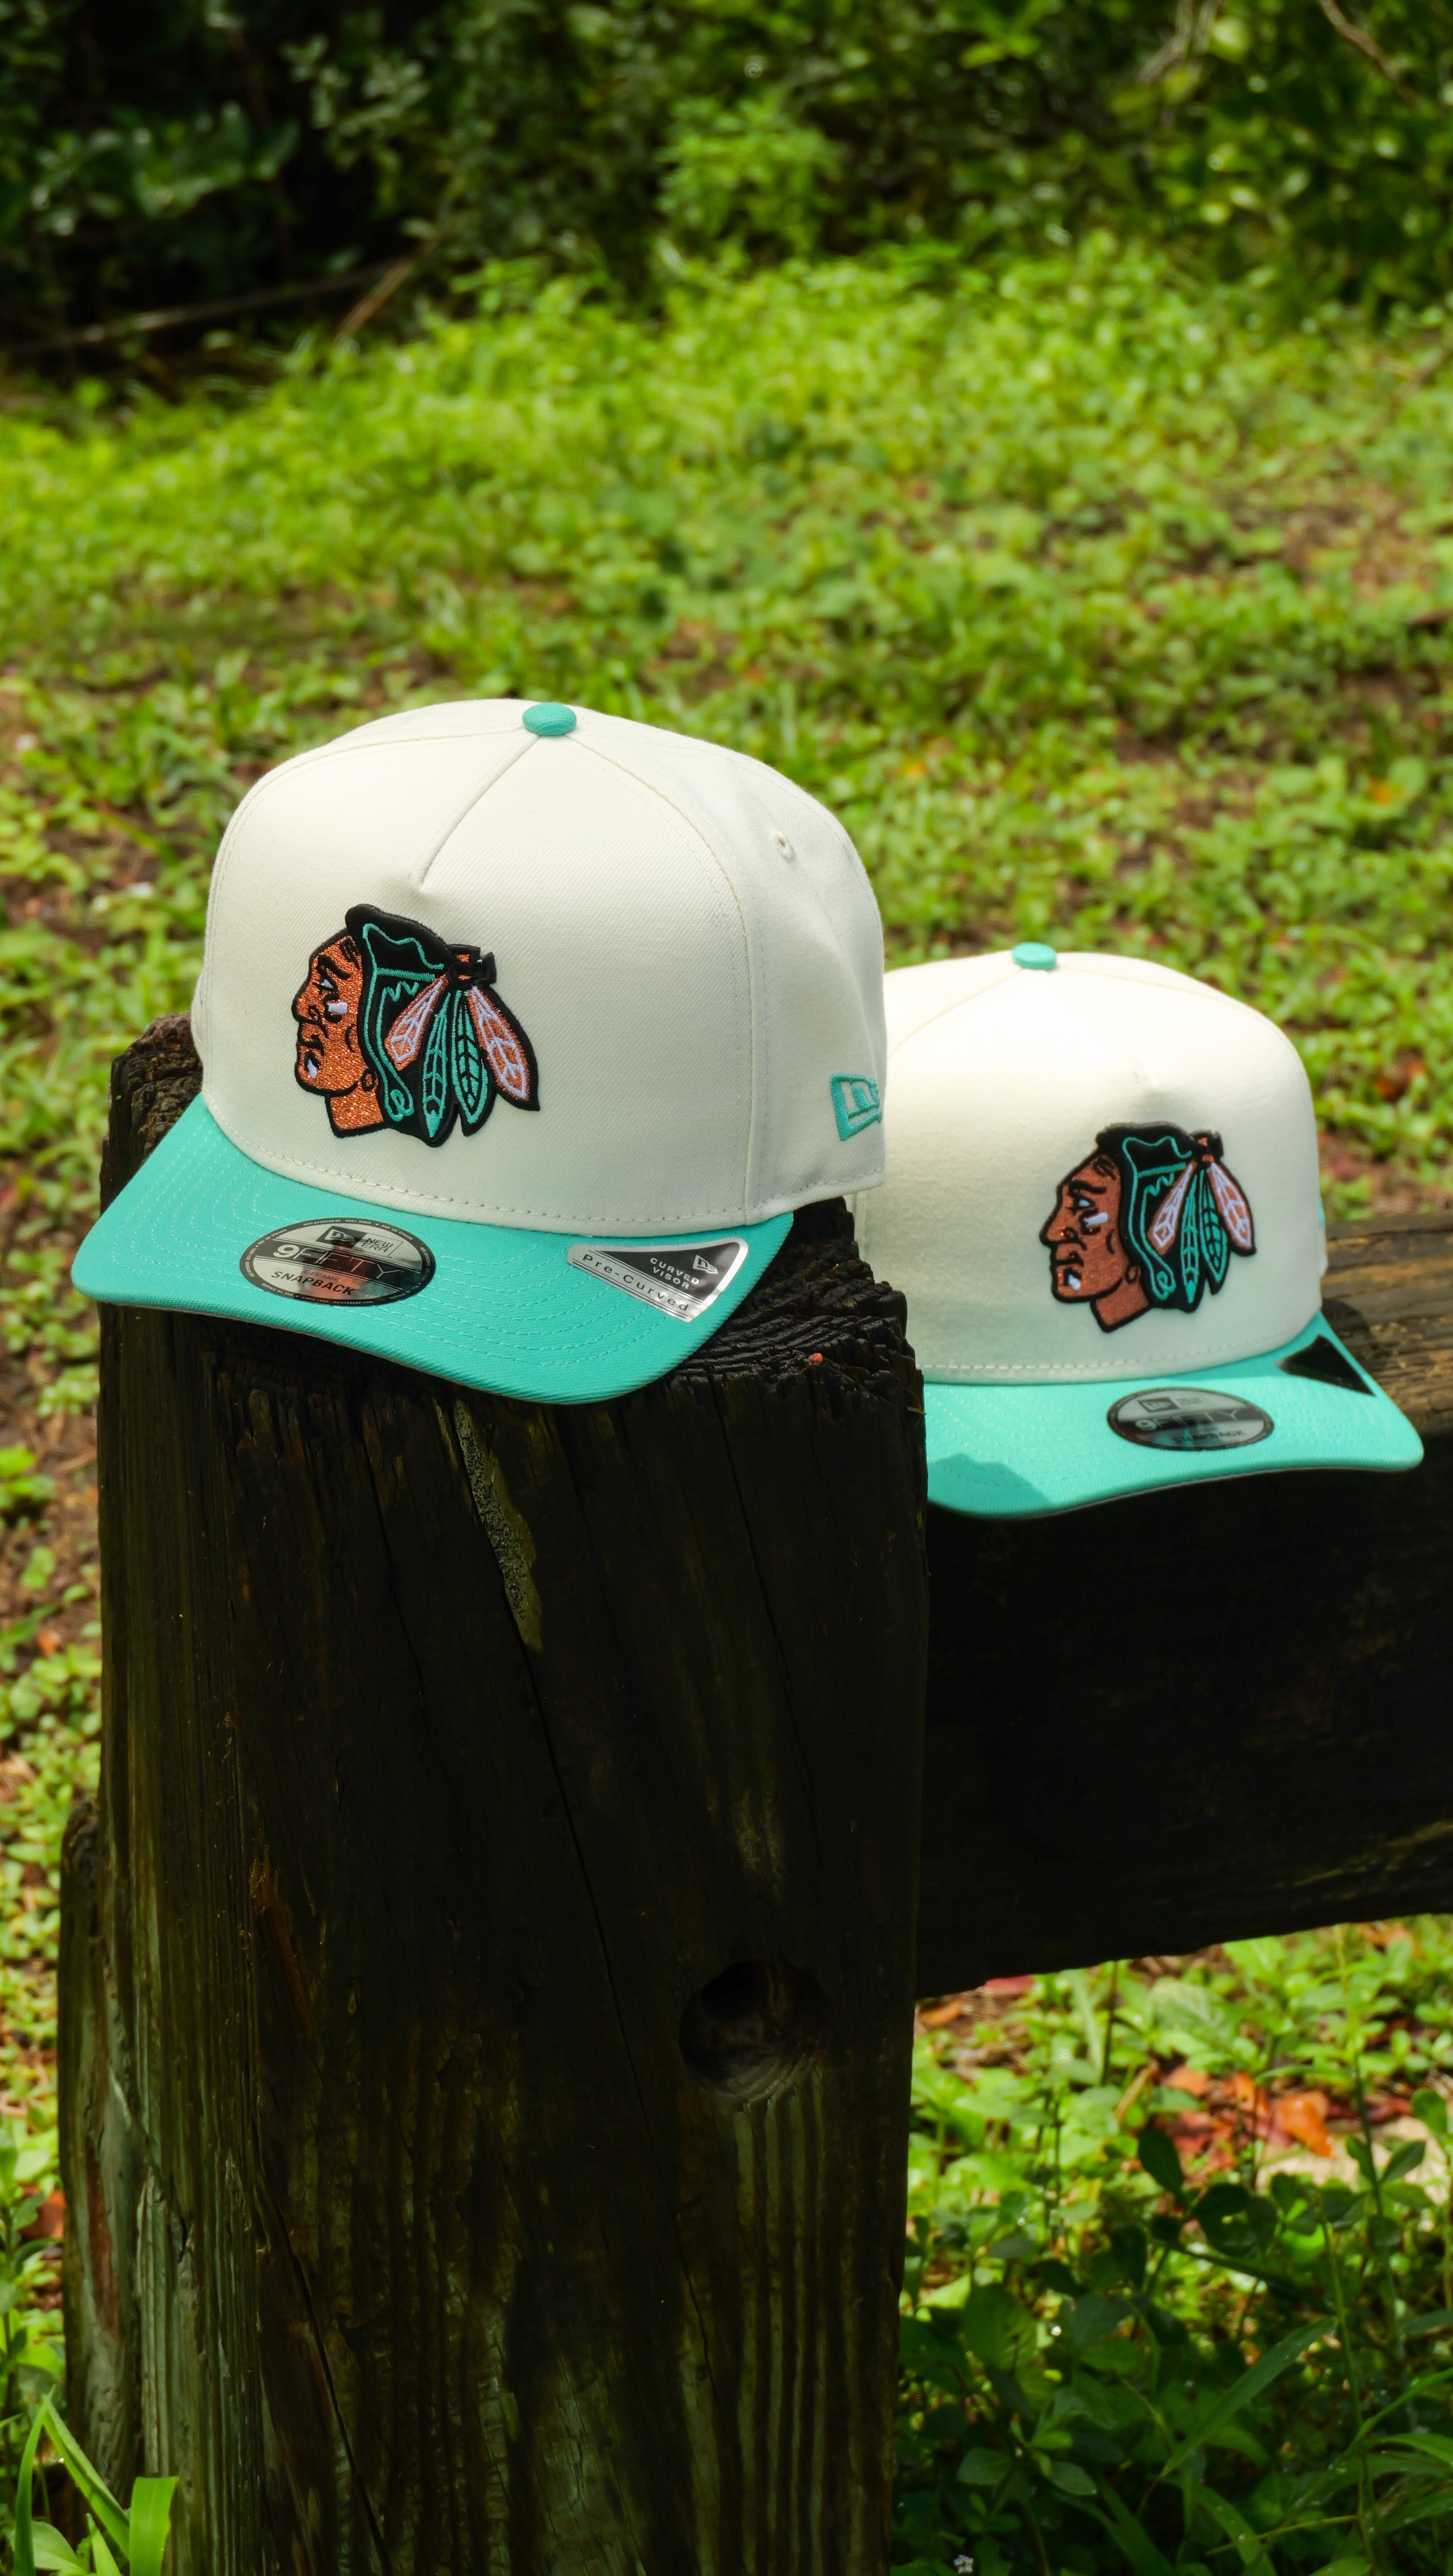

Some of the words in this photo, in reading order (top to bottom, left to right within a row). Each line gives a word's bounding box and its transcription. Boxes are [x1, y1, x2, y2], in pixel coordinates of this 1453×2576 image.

[361, 1242, 389, 1253] ERA
[365, 1237, 394, 1249] NEW
[273, 1244, 401, 1279] 9FIFTY
[650, 1257, 700, 1285] CURVED
[271, 1271, 357, 1296] SNAPBACK
[302, 1270, 341, 1282] A-FRAME
[582, 1254, 689, 1311] Pre-Curved
[653, 1266, 690, 1290] VISOR
